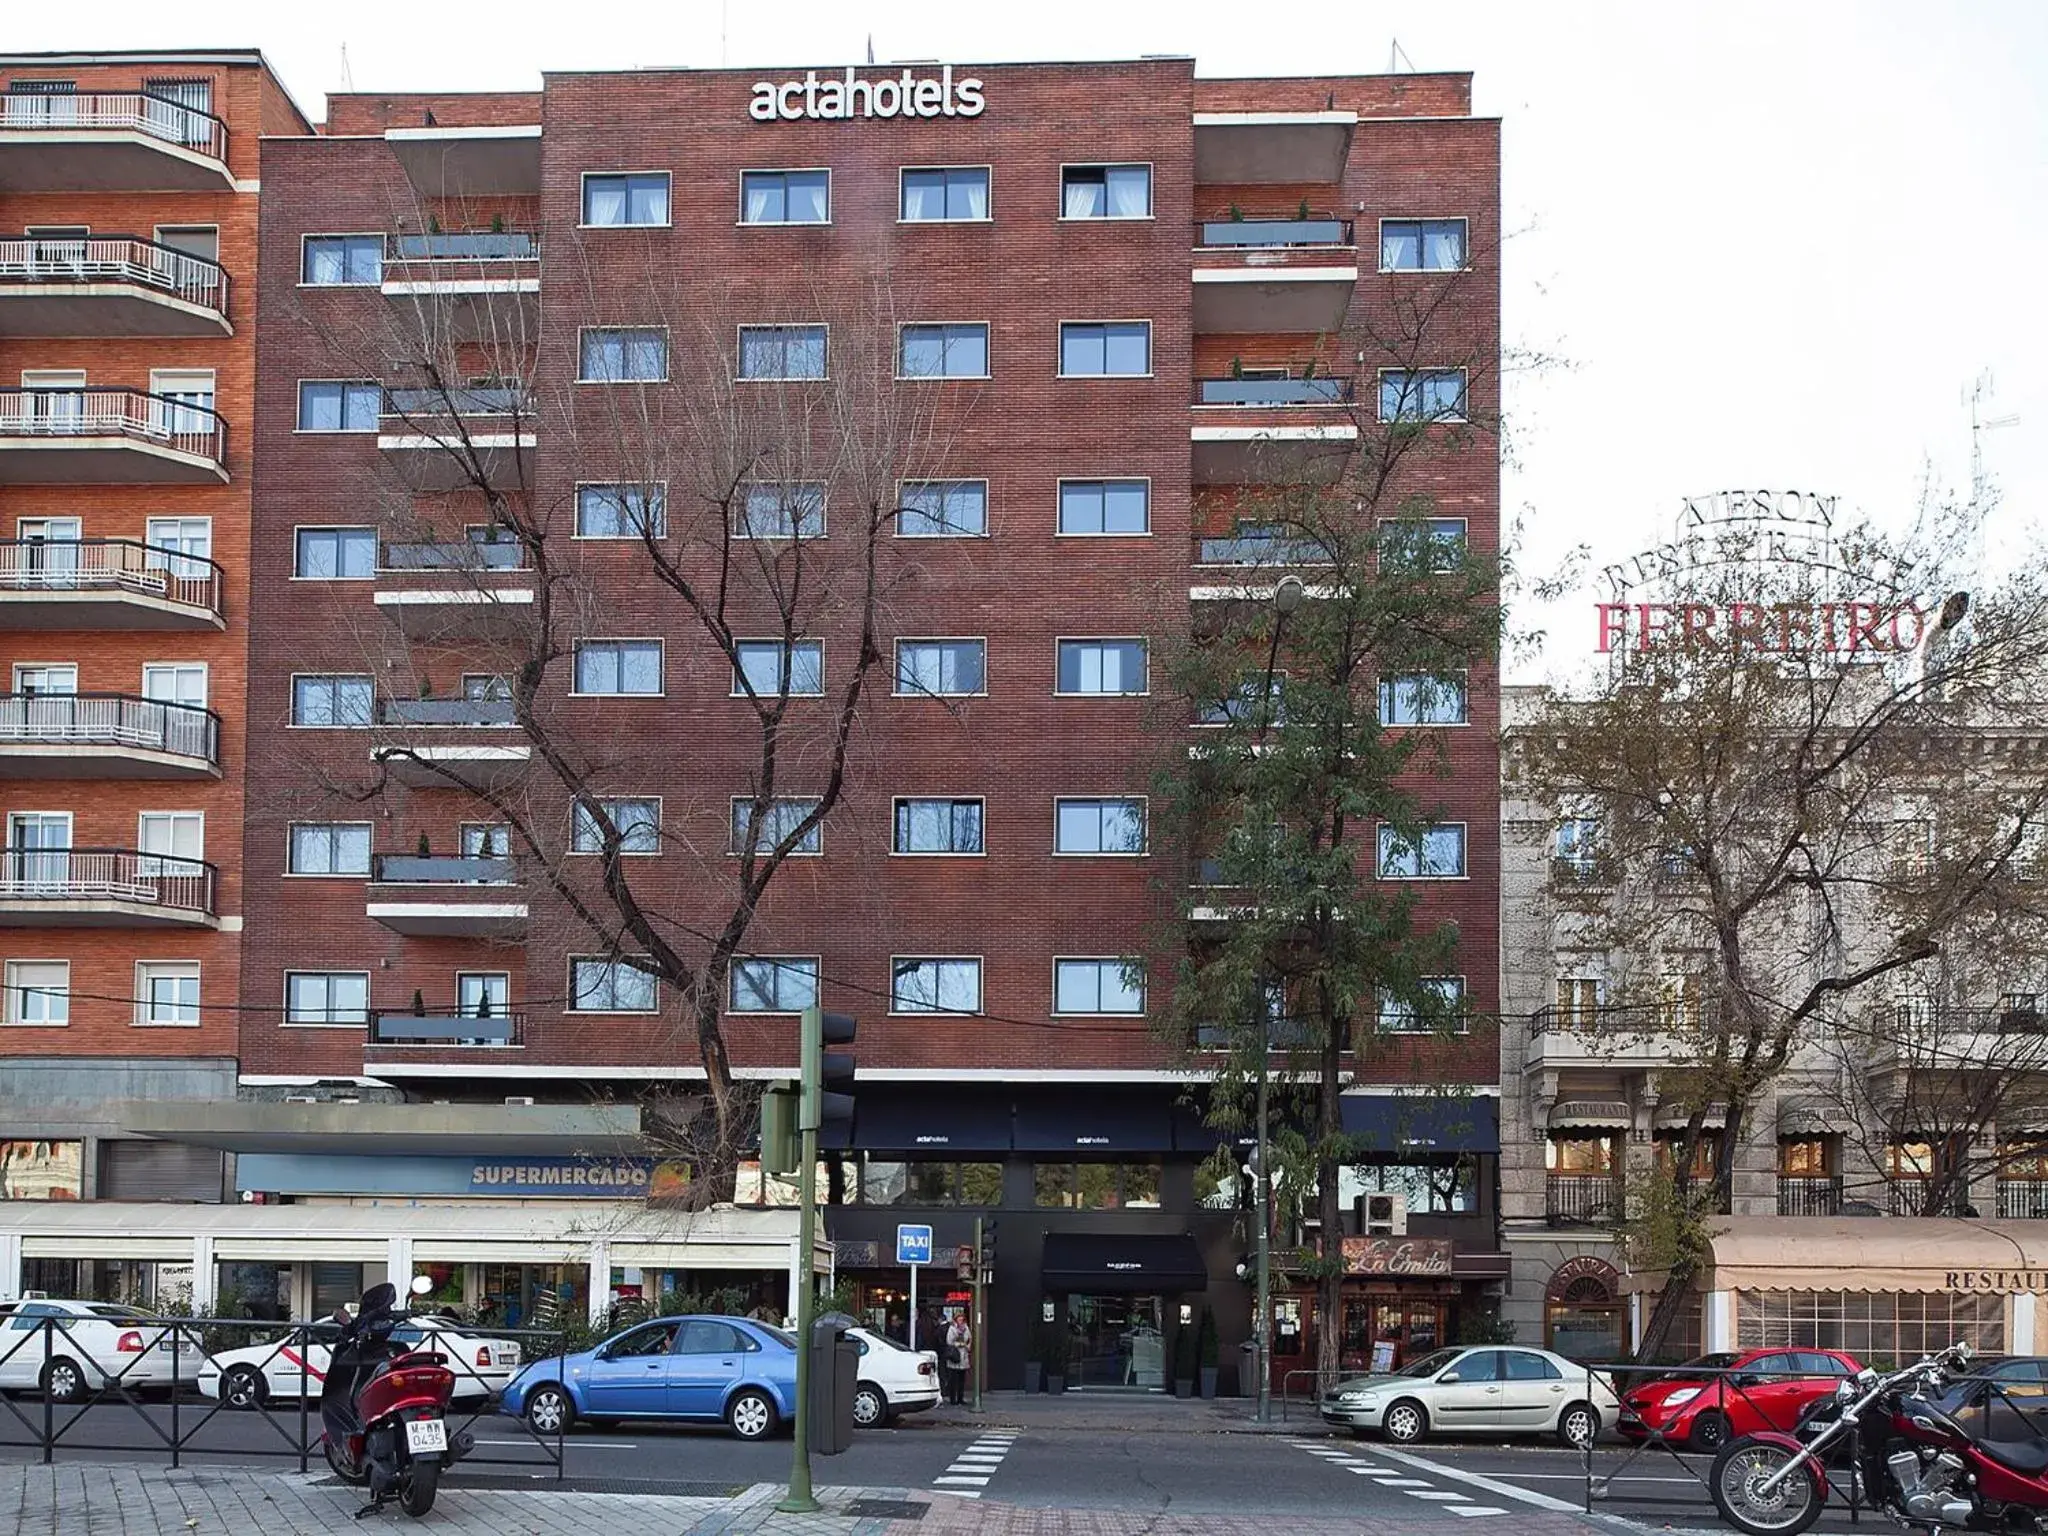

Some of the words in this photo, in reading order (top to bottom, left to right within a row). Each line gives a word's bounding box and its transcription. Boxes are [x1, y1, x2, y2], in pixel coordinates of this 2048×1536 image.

[749, 65, 985, 120] actahotels
[1594, 601, 1926, 654] FERREIRO
[472, 1166, 647, 1186] SUPERMERCADO
[901, 1235, 928, 1248] TAXI
